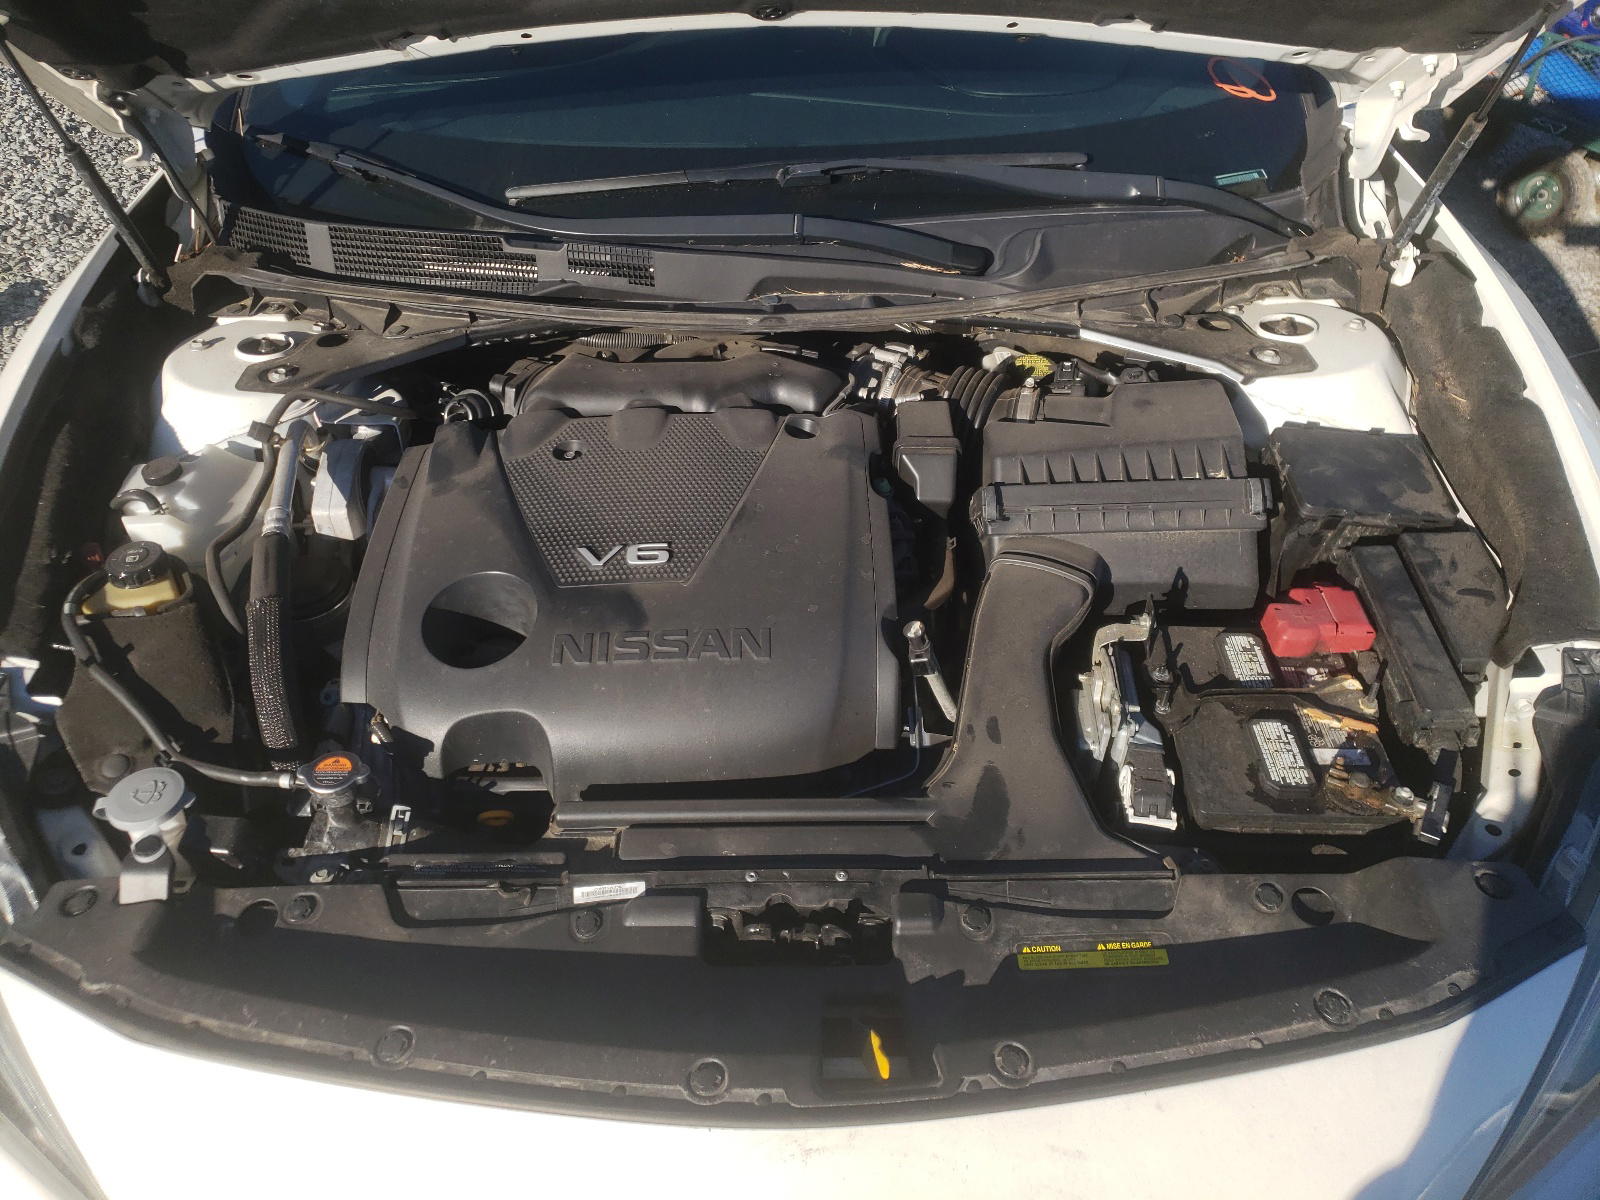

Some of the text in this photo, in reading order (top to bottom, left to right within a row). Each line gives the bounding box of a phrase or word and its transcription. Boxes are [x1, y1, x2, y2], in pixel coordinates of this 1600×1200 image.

[577, 543, 670, 566] V6
[552, 627, 772, 667] NISSAN
[1031, 945, 1061, 953] CAUTION
[1106, 942, 1121, 950] MISE
